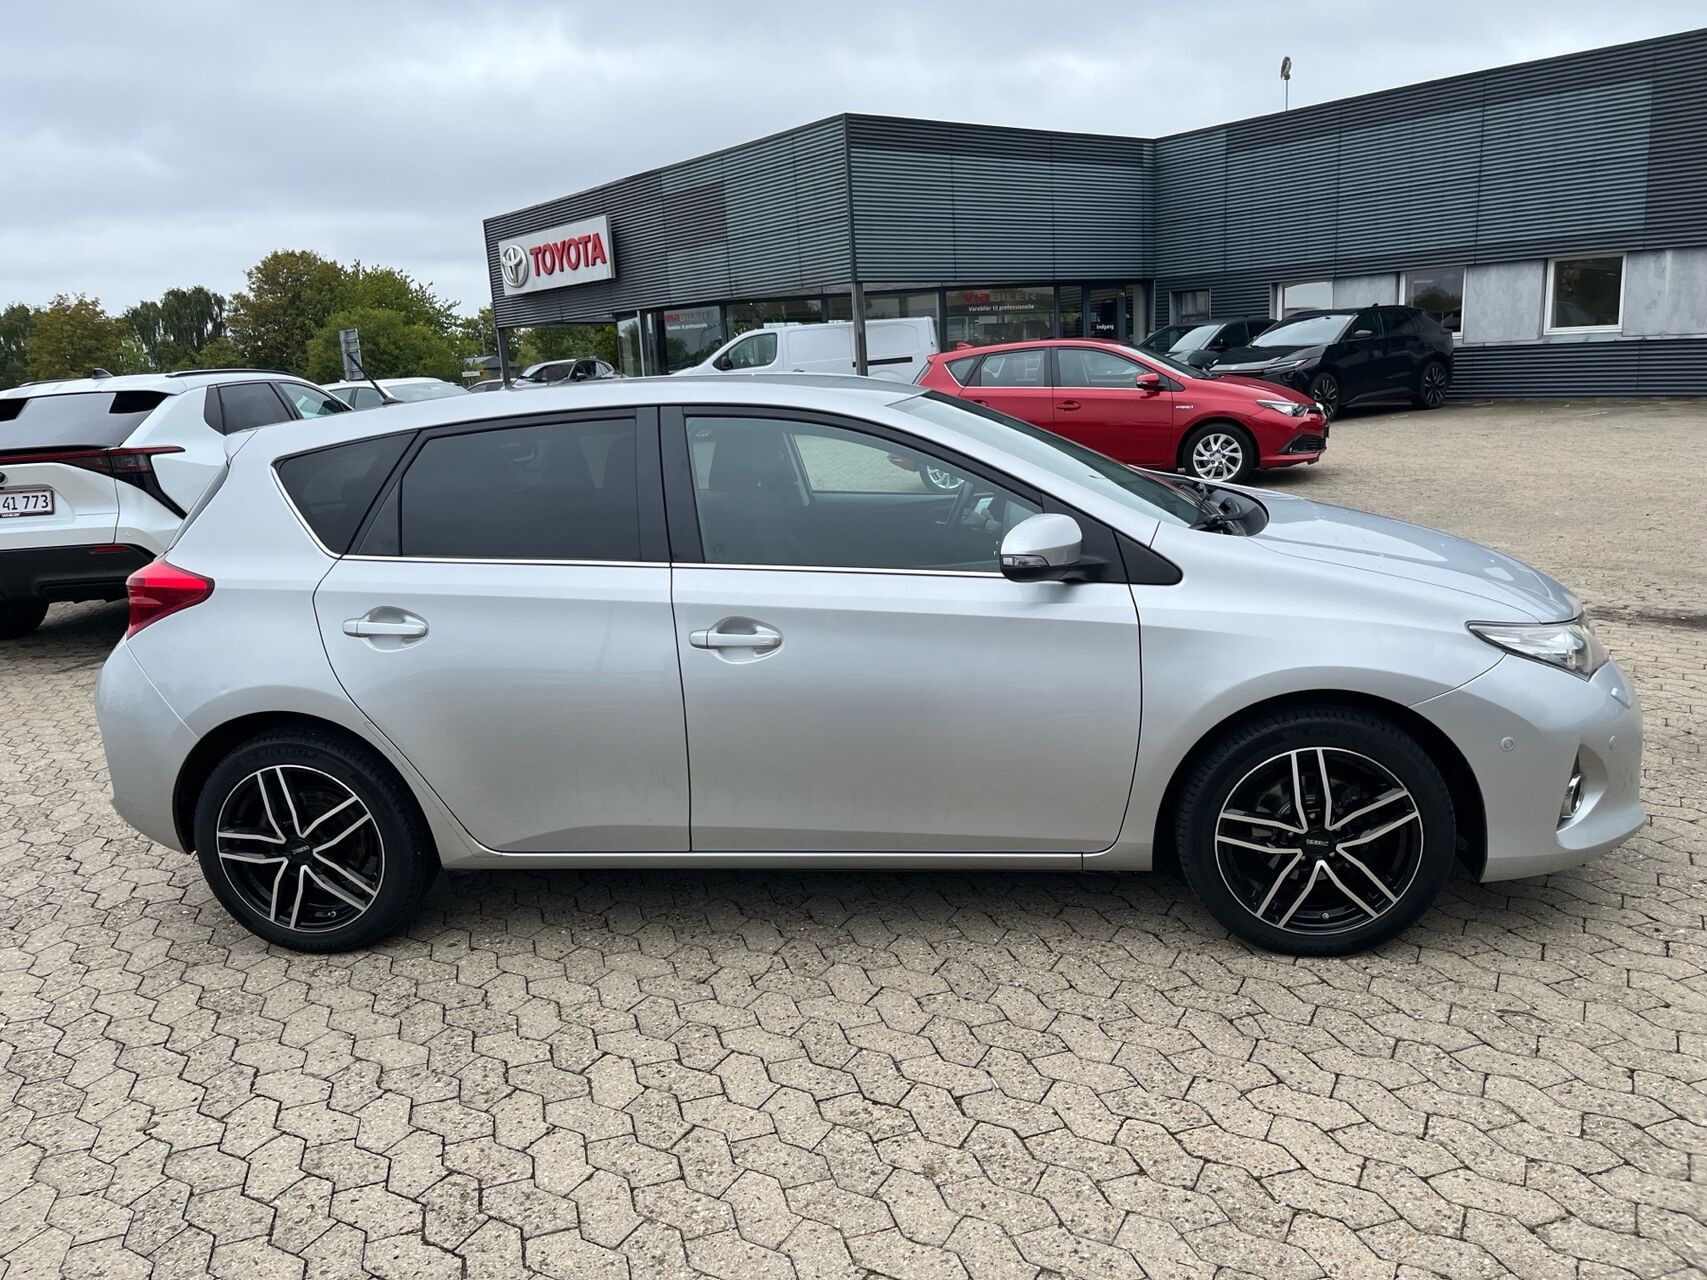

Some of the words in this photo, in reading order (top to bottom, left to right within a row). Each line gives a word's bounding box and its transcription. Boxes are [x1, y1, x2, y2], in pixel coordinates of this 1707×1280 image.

[529, 233, 607, 277] TOYOTA
[2, 496, 18, 511] 41
[22, 494, 49, 510] 773
